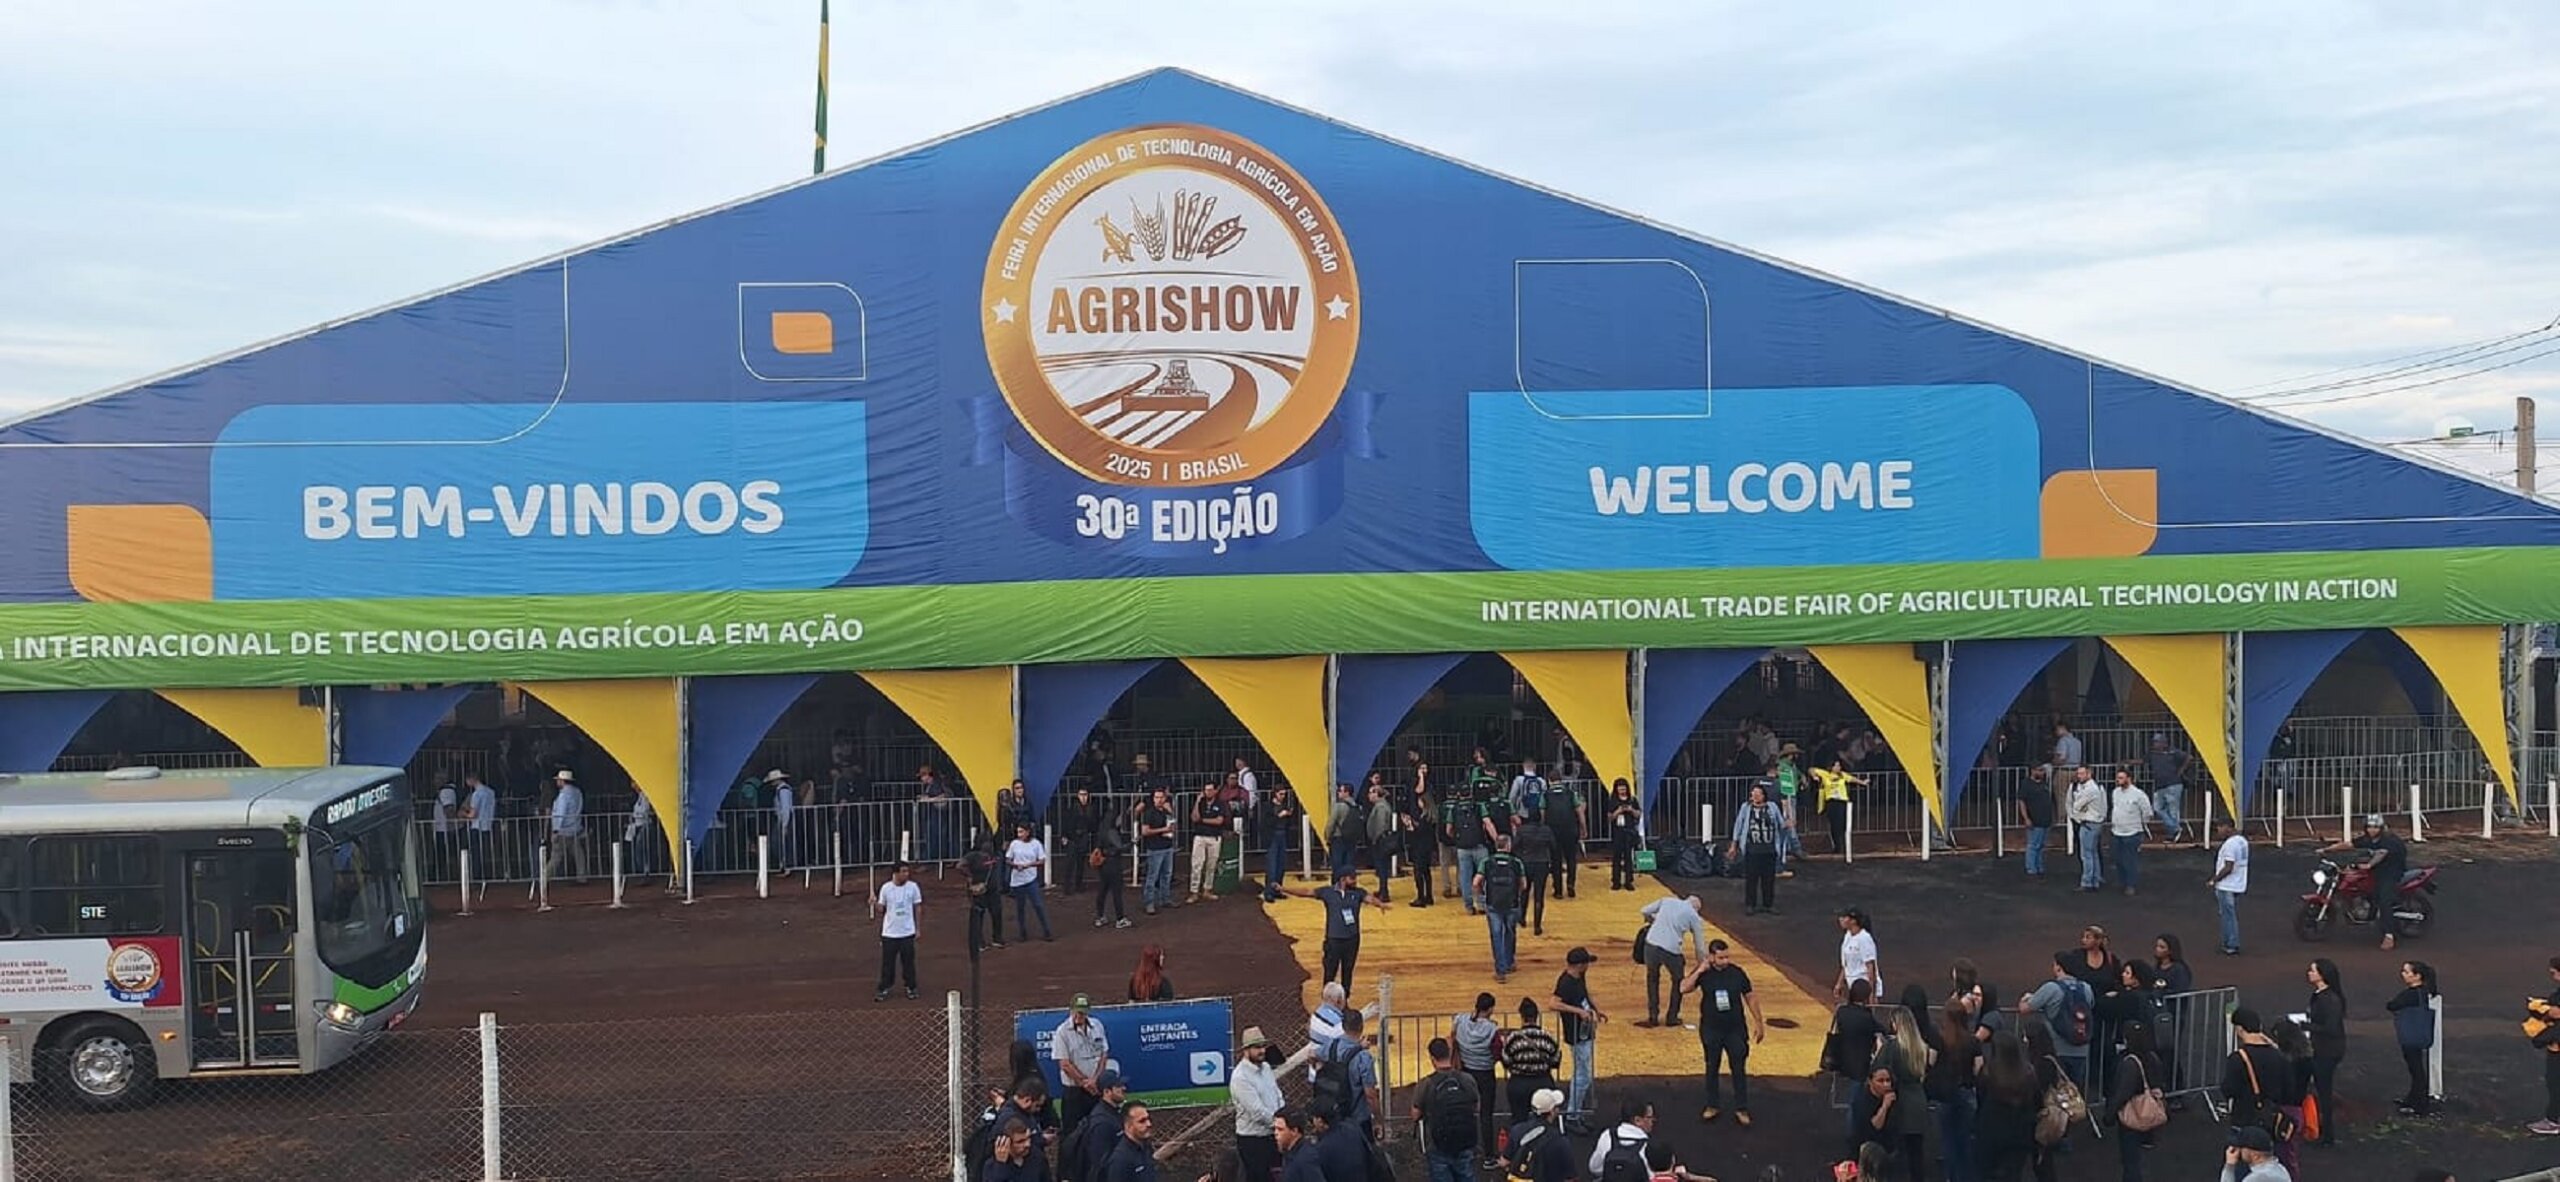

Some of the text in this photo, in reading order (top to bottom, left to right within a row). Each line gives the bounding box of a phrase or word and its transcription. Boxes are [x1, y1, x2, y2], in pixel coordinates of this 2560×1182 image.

[1001, 138, 1339, 281] FEIRA INTERNACIONAL DE TECNOLOGIA AGRÍCOLA EM AÇÃO
[1046, 284, 1301, 335] AGRISHOW
[1104, 452, 1152, 480] 2025
[1179, 450, 1249, 481] BRASIL
[1588, 460, 1915, 516] WELCOME
[302, 479, 785, 541] BEM-VINDOS
[1152, 486, 1279, 554] EDIÇÃO
[1481, 577, 2398, 623] INTERNATIONAL TRADE FAIR OF AGRICULTURAL TECHNOLOGY IN ACTION
[13, 631, 281, 660] INTERNACIONAL
[290, 630, 332, 656] DE
[339, 627, 548, 656] TECNOLOGIA
[556, 618, 716, 651] AGRÍCOLA
[724, 622, 770, 646] EM
[778, 614, 864, 649] AÇÃO
[81, 906, 107, 919] STE
[1140, 1022, 1188, 1034] ENTRADA
[1140, 1030, 1199, 1043] VISITANTES
